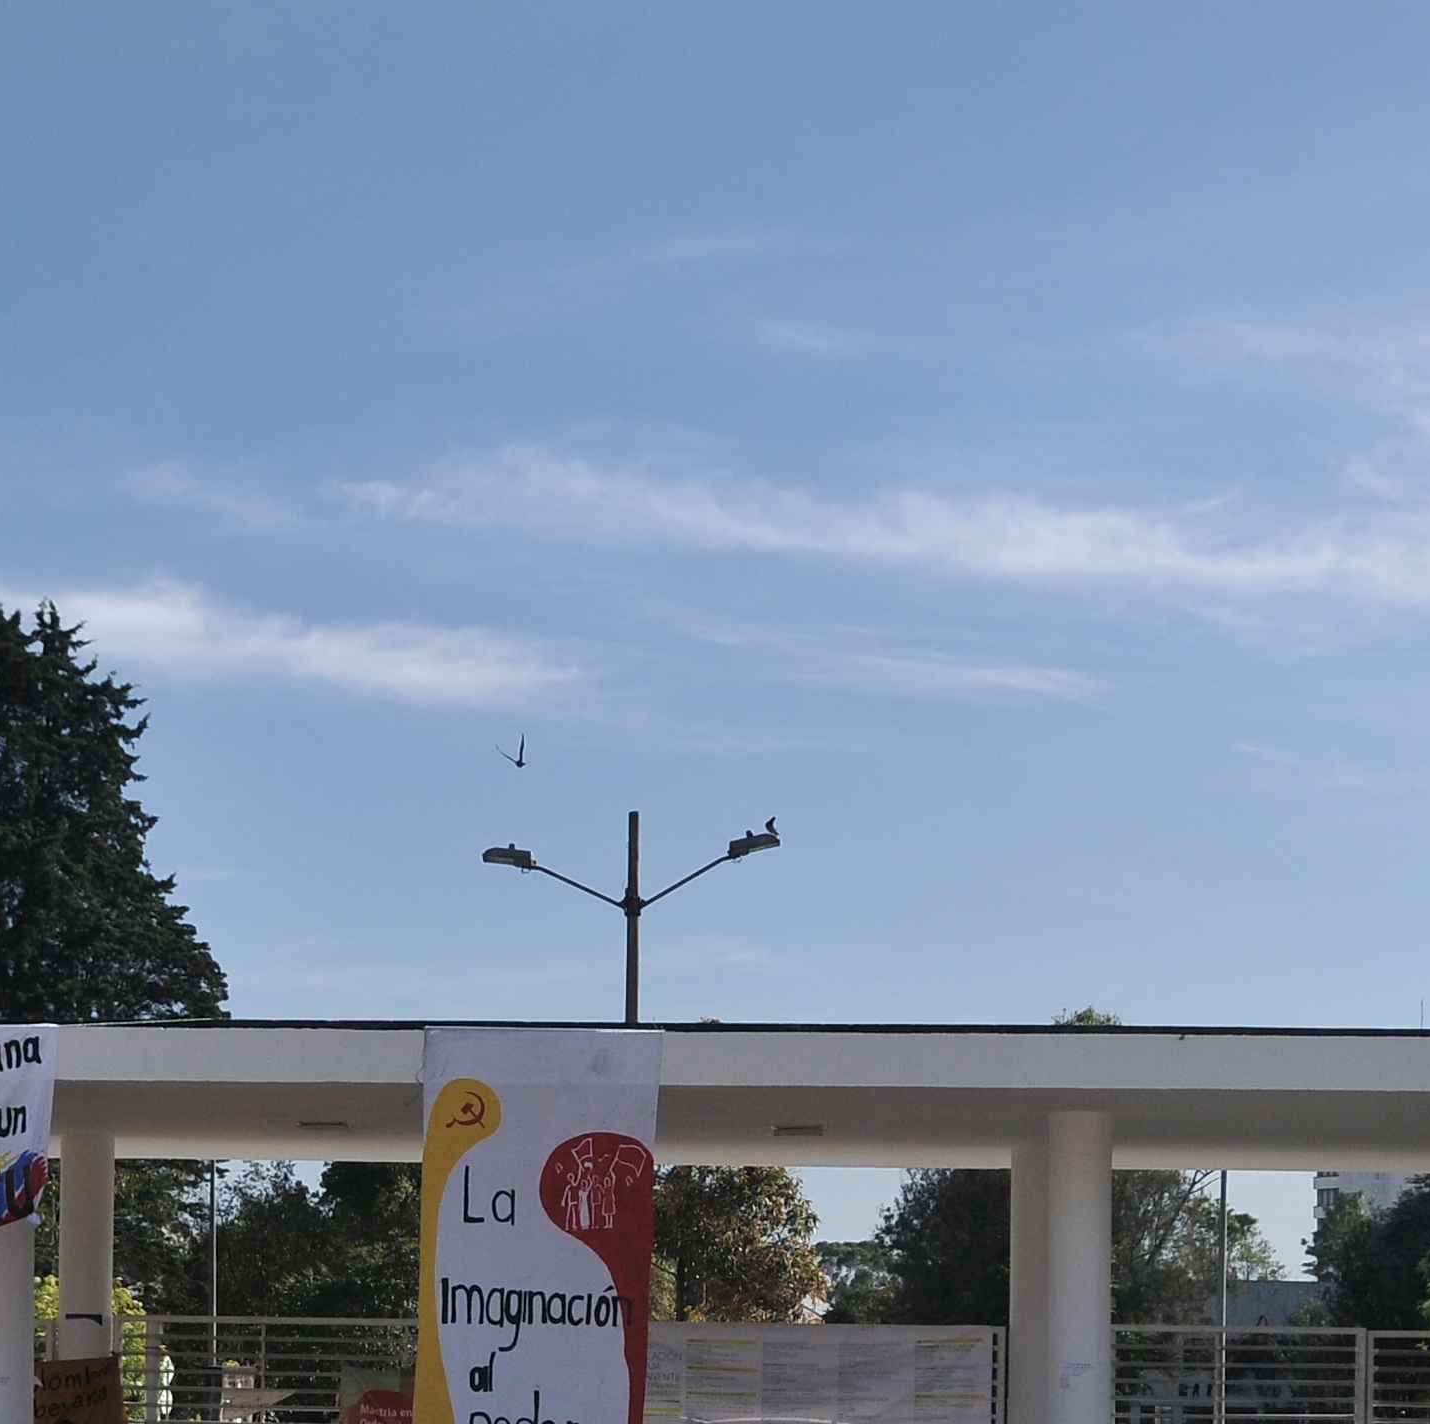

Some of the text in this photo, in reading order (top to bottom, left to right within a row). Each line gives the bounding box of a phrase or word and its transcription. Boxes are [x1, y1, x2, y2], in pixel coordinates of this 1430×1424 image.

[463, 1165, 516, 1225] La
[440, 1277, 633, 1351] Imaginación
[469, 1352, 495, 1392] al
